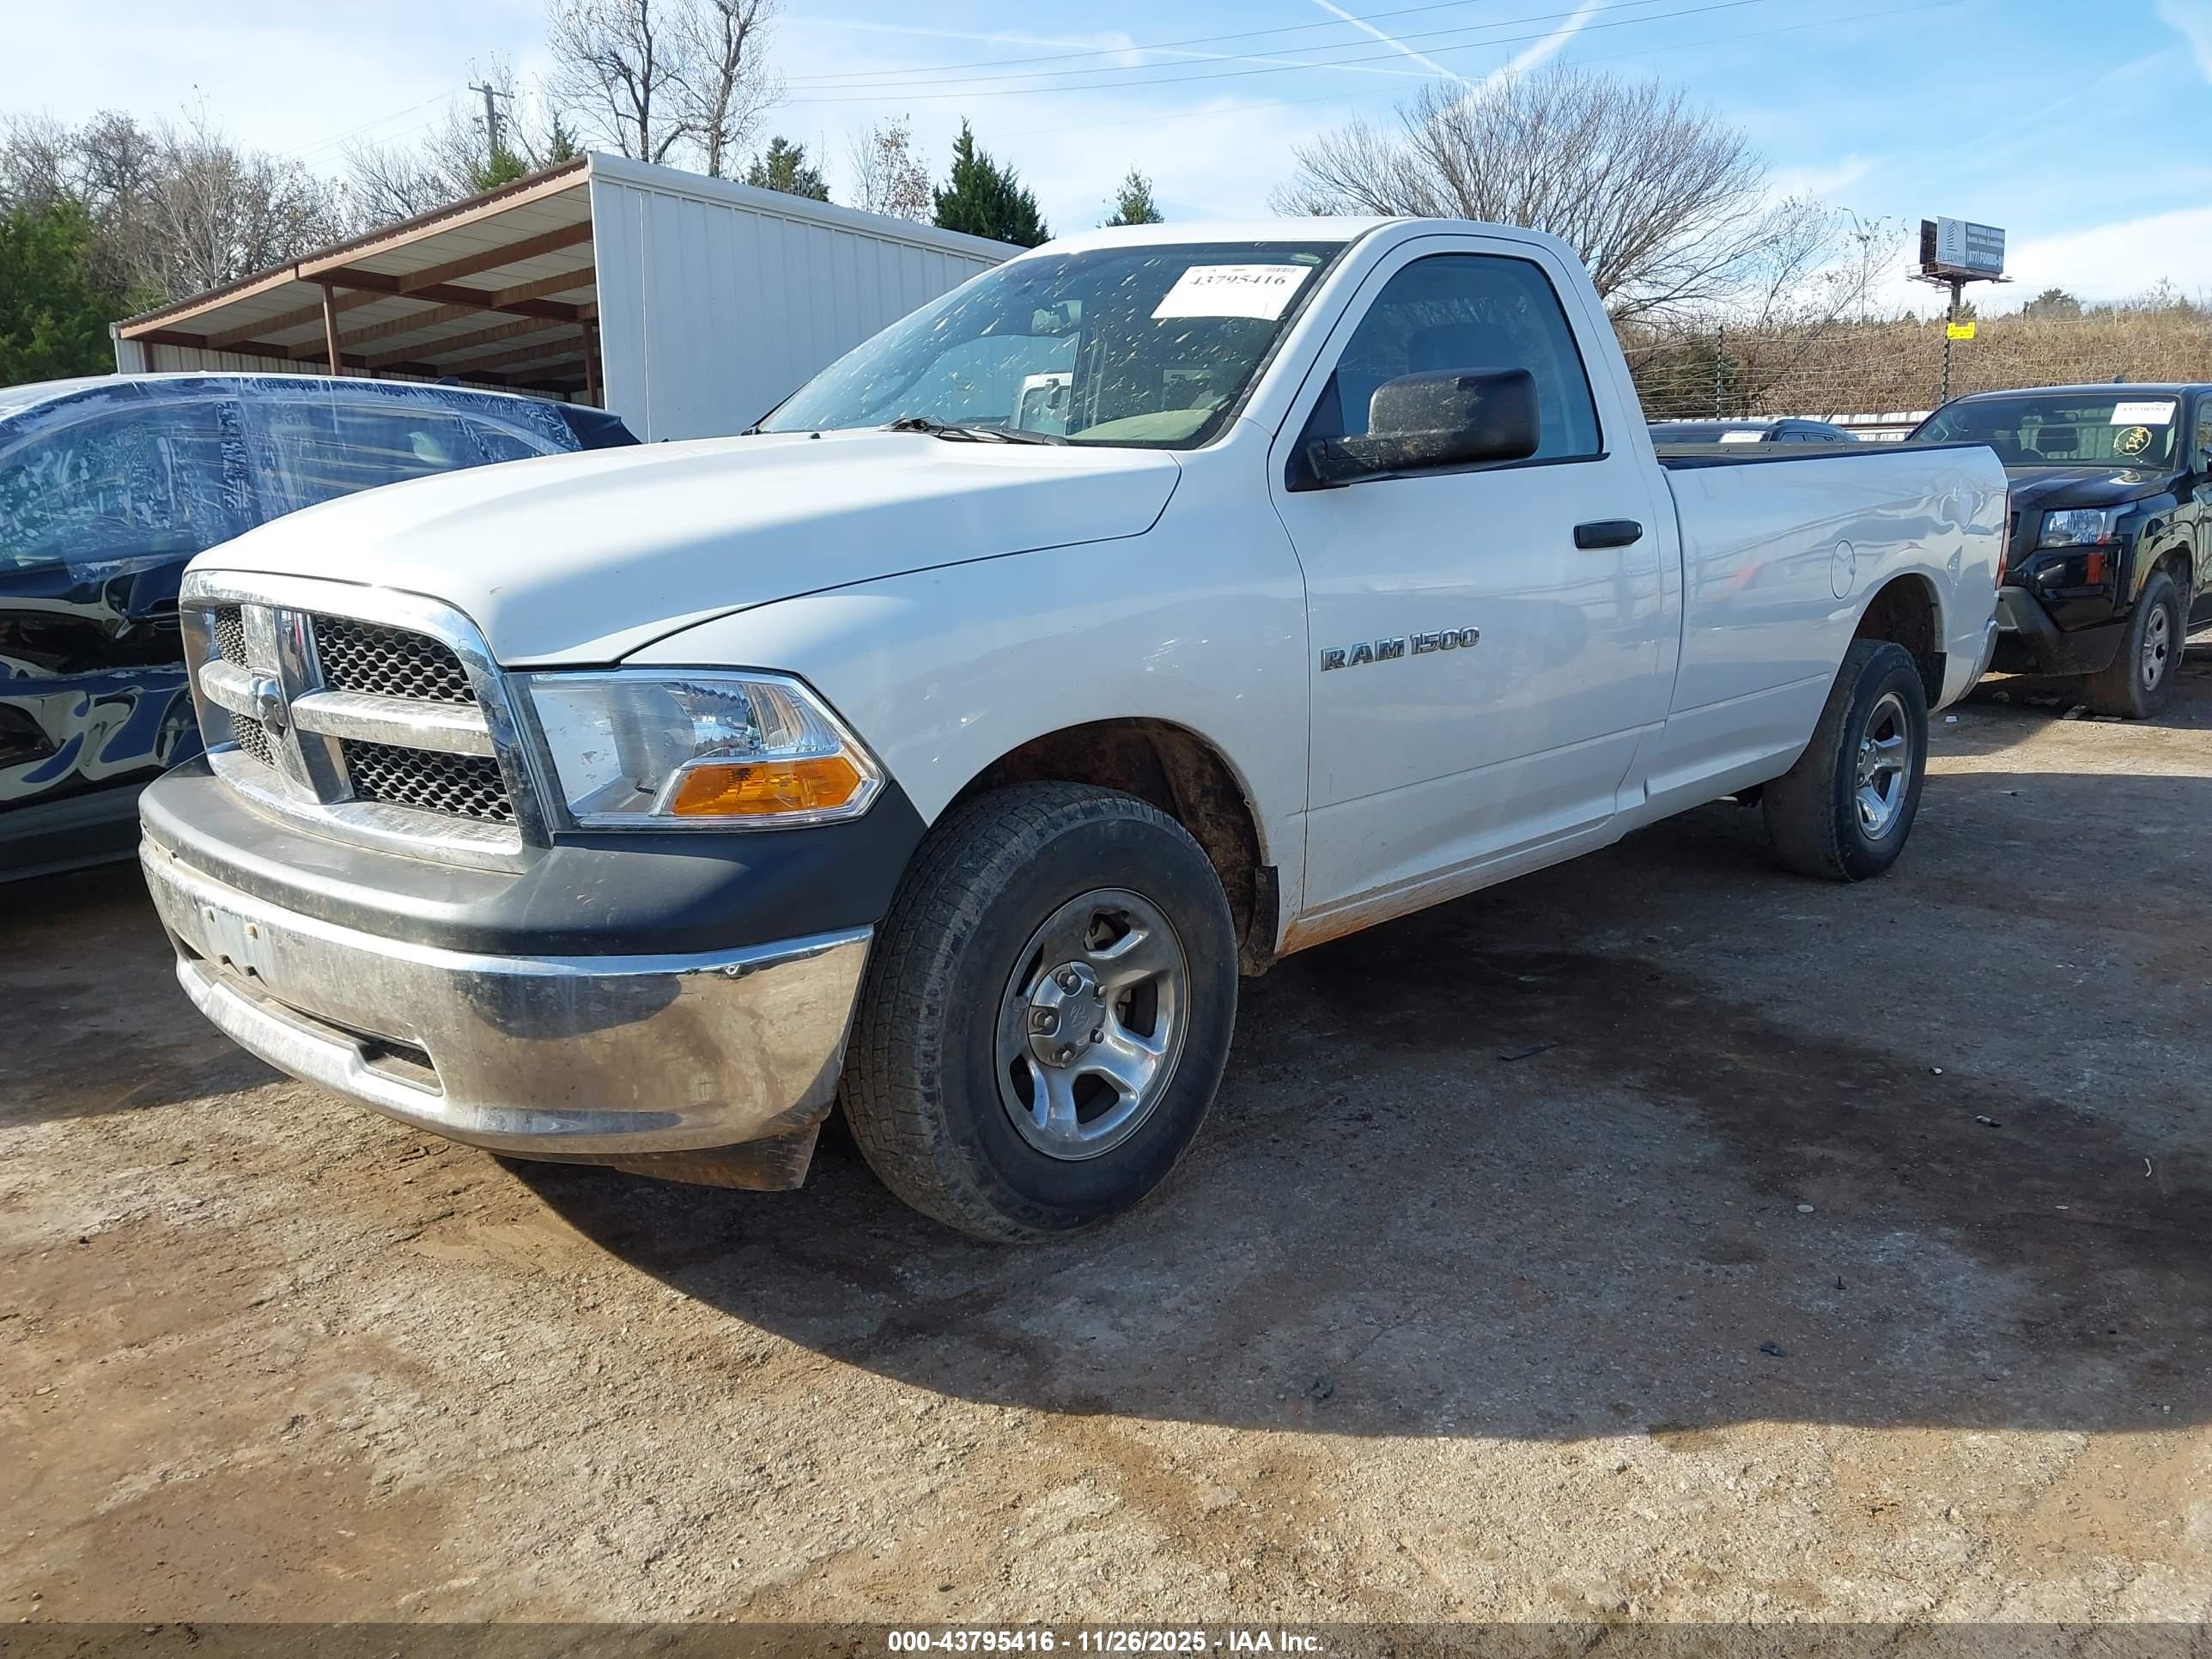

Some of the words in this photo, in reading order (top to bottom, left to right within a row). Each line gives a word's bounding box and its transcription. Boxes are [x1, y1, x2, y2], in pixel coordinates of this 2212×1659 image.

[1189, 274, 1286, 286] 43795416
[1321, 635, 1405, 672] RAM
[1410, 625, 1480, 655] 1500
